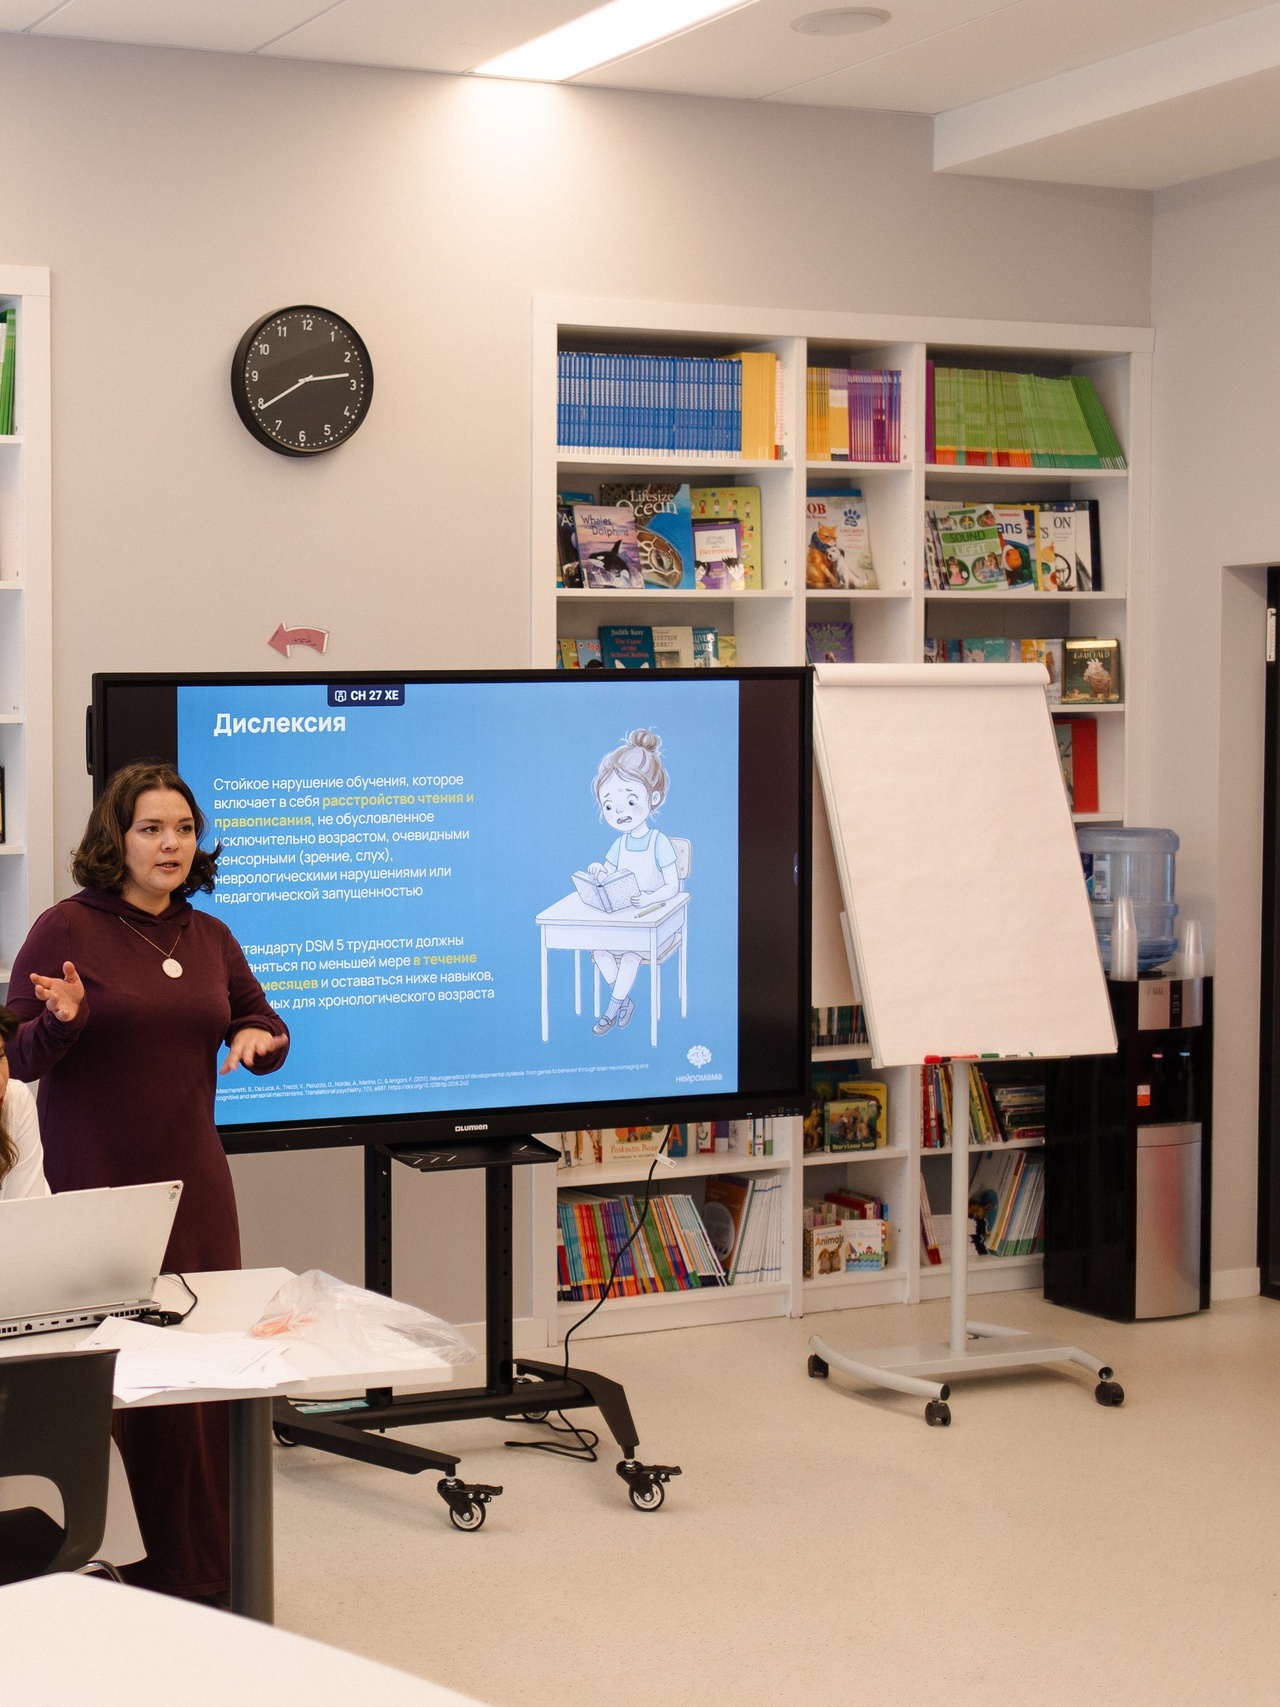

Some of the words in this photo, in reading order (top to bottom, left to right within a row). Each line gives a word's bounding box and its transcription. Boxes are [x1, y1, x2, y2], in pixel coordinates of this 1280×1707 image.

[278, 326, 287, 337] 11
[302, 320, 313, 331] 12
[330, 331, 335, 342] 1
[259, 344, 270, 355] 10
[344, 352, 351, 362] 2
[252, 370, 258, 382] 9
[350, 380, 356, 390] 3
[258, 398, 264, 408] 8
[344, 406, 350, 416] 4
[275, 420, 282, 430] 7
[324, 424, 331, 436] 5
[299, 430, 306, 442] 6
[630, 490, 674, 503] Lifesize
[616, 500, 678, 517] Ocean
[580, 514, 612, 526] Whales
[592, 526, 630, 537] Dolphins
[950, 530, 986, 544] SOUND
[700, 548, 734, 556] Electronics
[956, 544, 988, 556] LIGHT
[369, 690, 382, 701] 27
[214, 713, 346, 736] Дислексия
[214, 776, 270, 791] Стойкое
[272, 778, 344, 792] нарушение
[346, 775, 409, 792] обучения,
[412, 775, 464, 789] которое
[214, 798, 276, 810] включает
[279, 799, 287, 808] в
[289, 796, 320, 808] себя
[322, 794, 415, 810] расстройство
[418, 794, 464, 804] чтения
[466, 794, 474, 803] и
[214, 815, 315, 831] правописания,
[318, 816, 334, 826] не
[336, 812, 435, 828] обусловленное
[214, 834, 316, 847] исключительно
[318, 832, 390, 846] возрастом,
[392, 829, 470, 842] очевидными
[215, 853, 296, 870] сенсорными
[299, 849, 353, 867] (зрение,
[356, 848, 394, 864] слух),
[215, 872, 338, 887] неврологическими
[340, 868, 427, 884] нарушениями
[429, 866, 452, 878] или
[215, 888, 319, 905] педагогической
[322, 885, 423, 902] запущенностью
[241, 942, 303, 958] тандарту
[305, 940, 334, 952] DSM
[336, 939, 344, 951] 5
[346, 937, 413, 953] трудности
[416, 936, 464, 950] должны
[300, 961, 316, 971] по
[319, 957, 376, 970] меньшей
[379, 957, 410, 969] мере
[414, 956, 421, 966] в
[423, 954, 478, 966] течение
[262, 980, 318, 994] месяцев
[321, 979, 328, 988] и
[331, 976, 403, 988] оставаться
[405, 974, 438, 984] ниже
[440, 970, 494, 983] навыков,
[292, 997, 316, 1010] для
[318, 990, 436, 1008] хронологического
[438, 988, 494, 1003] возраста
[676, 1072, 722, 1084] нейромама
[610, 1144, 640, 1153] Postman
[815, 1234, 844, 1246] Animals
